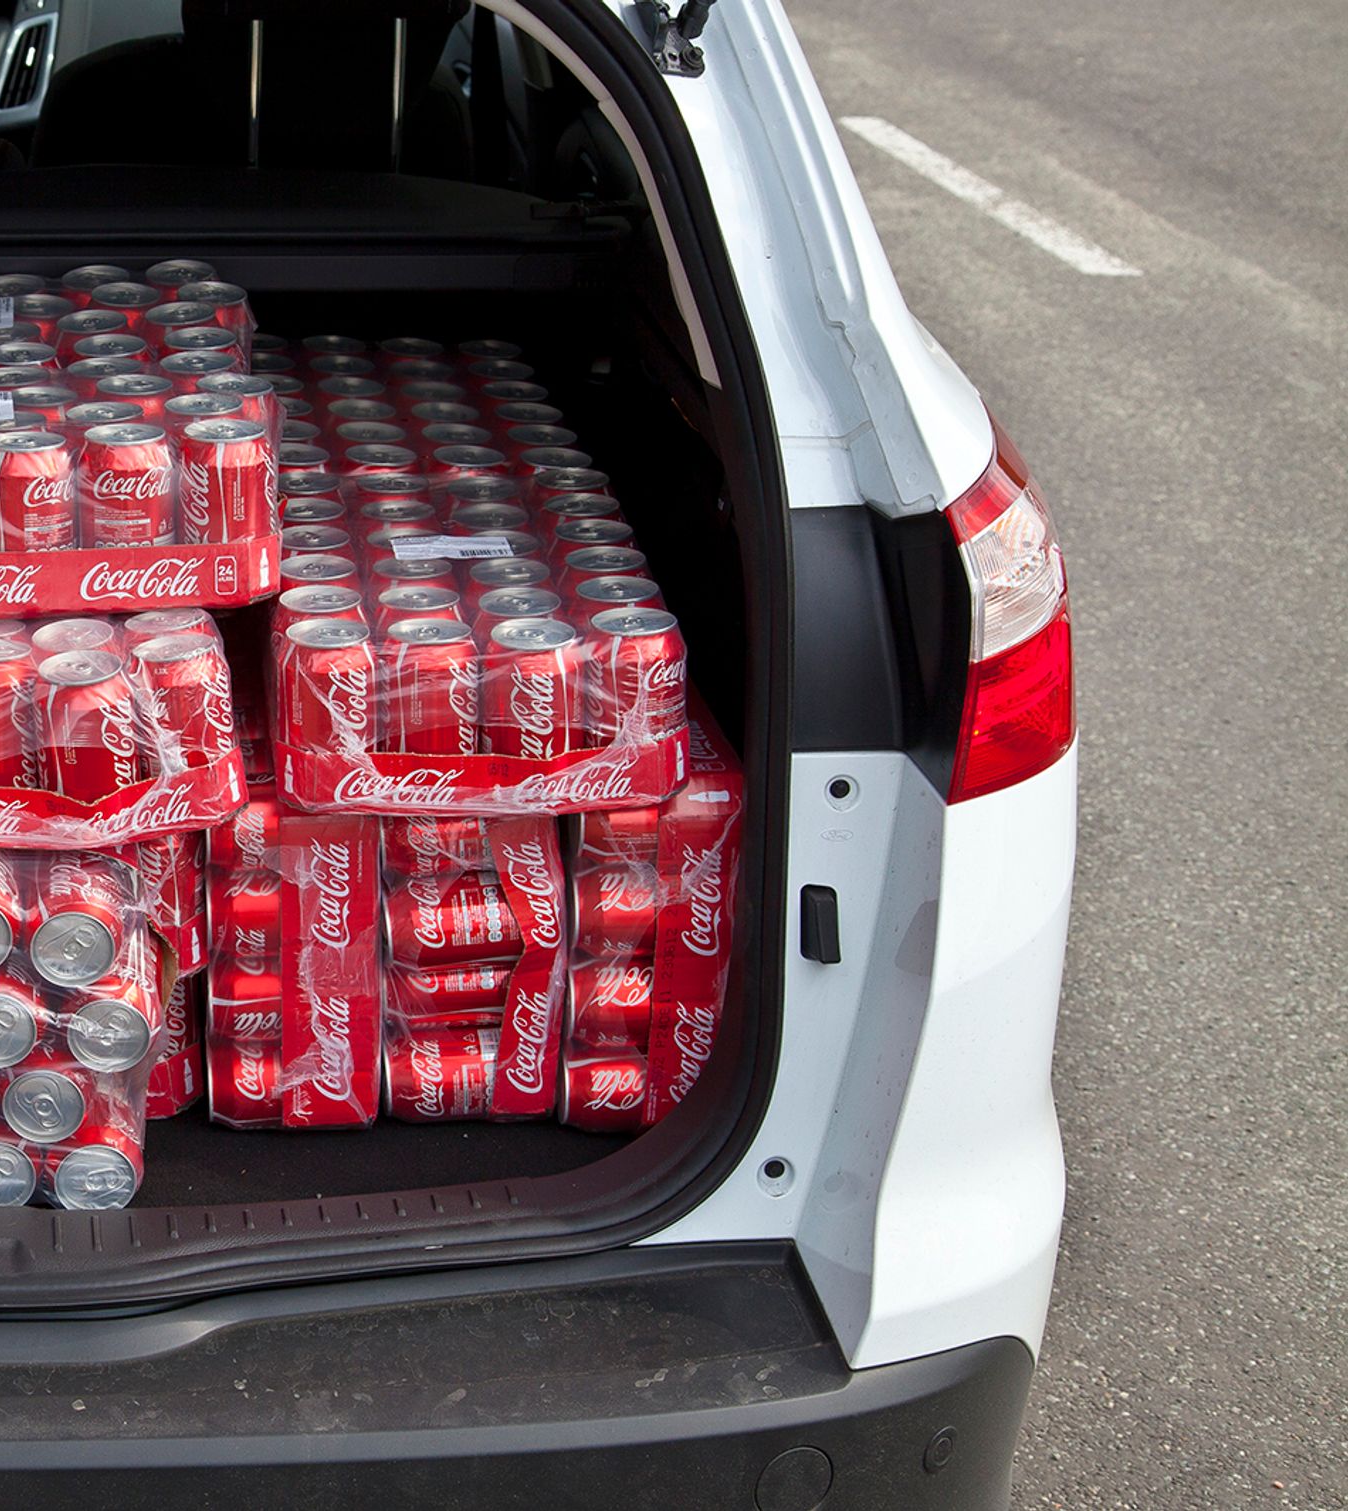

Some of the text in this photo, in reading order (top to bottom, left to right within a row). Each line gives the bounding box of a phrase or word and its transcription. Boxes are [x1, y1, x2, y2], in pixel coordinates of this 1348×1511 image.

[80, 557, 205, 601] Coca-Cola
[218, 565, 233, 576] 24
[101, 692, 136, 791] ca-Cola
[199, 663, 235, 758] a-Cola
[448, 657, 480, 755] ca-Cola
[510, 662, 555, 759] ca-Cola
[334, 768, 466, 805] Coca-Cola
[309, 836, 351, 949] Coca-Cola
[502, 841, 562, 950] Coca-Cola
[311, 993, 352, 1101] Coca-Cola
[409, 1036, 444, 1117] Coca-Cola
[506, 987, 549, 1094] Coca-Cola
